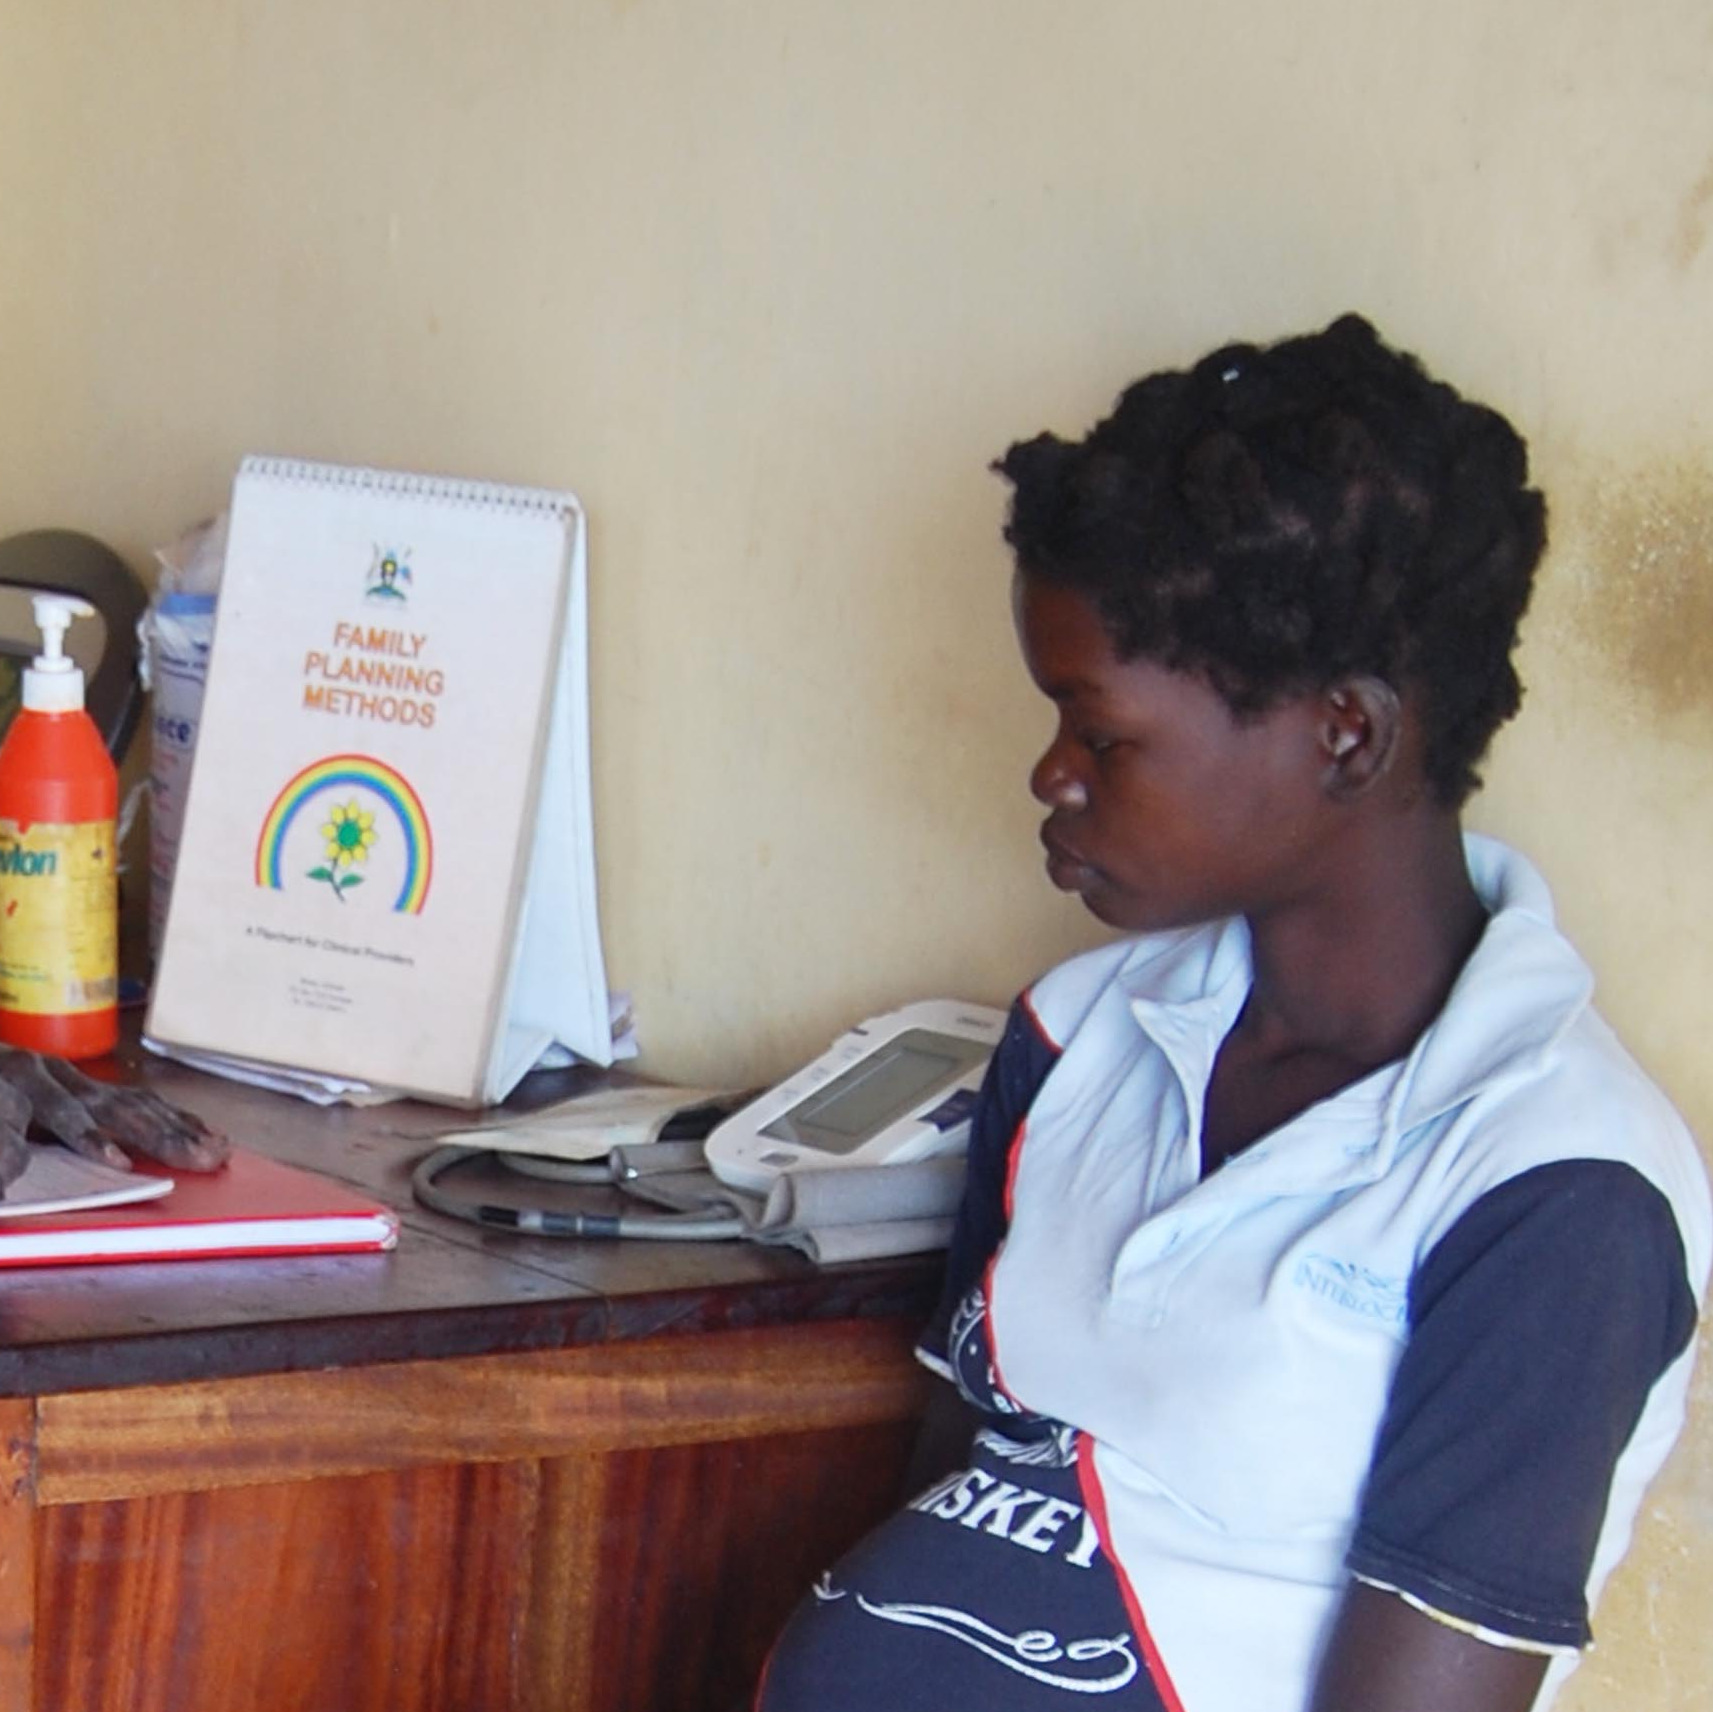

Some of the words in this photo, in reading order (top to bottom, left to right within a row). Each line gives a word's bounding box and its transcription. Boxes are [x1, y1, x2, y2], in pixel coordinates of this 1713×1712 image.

[333, 621, 426, 658] FAMILY
[303, 650, 445, 697] PLANNING
[302, 683, 437, 729] METHODS
